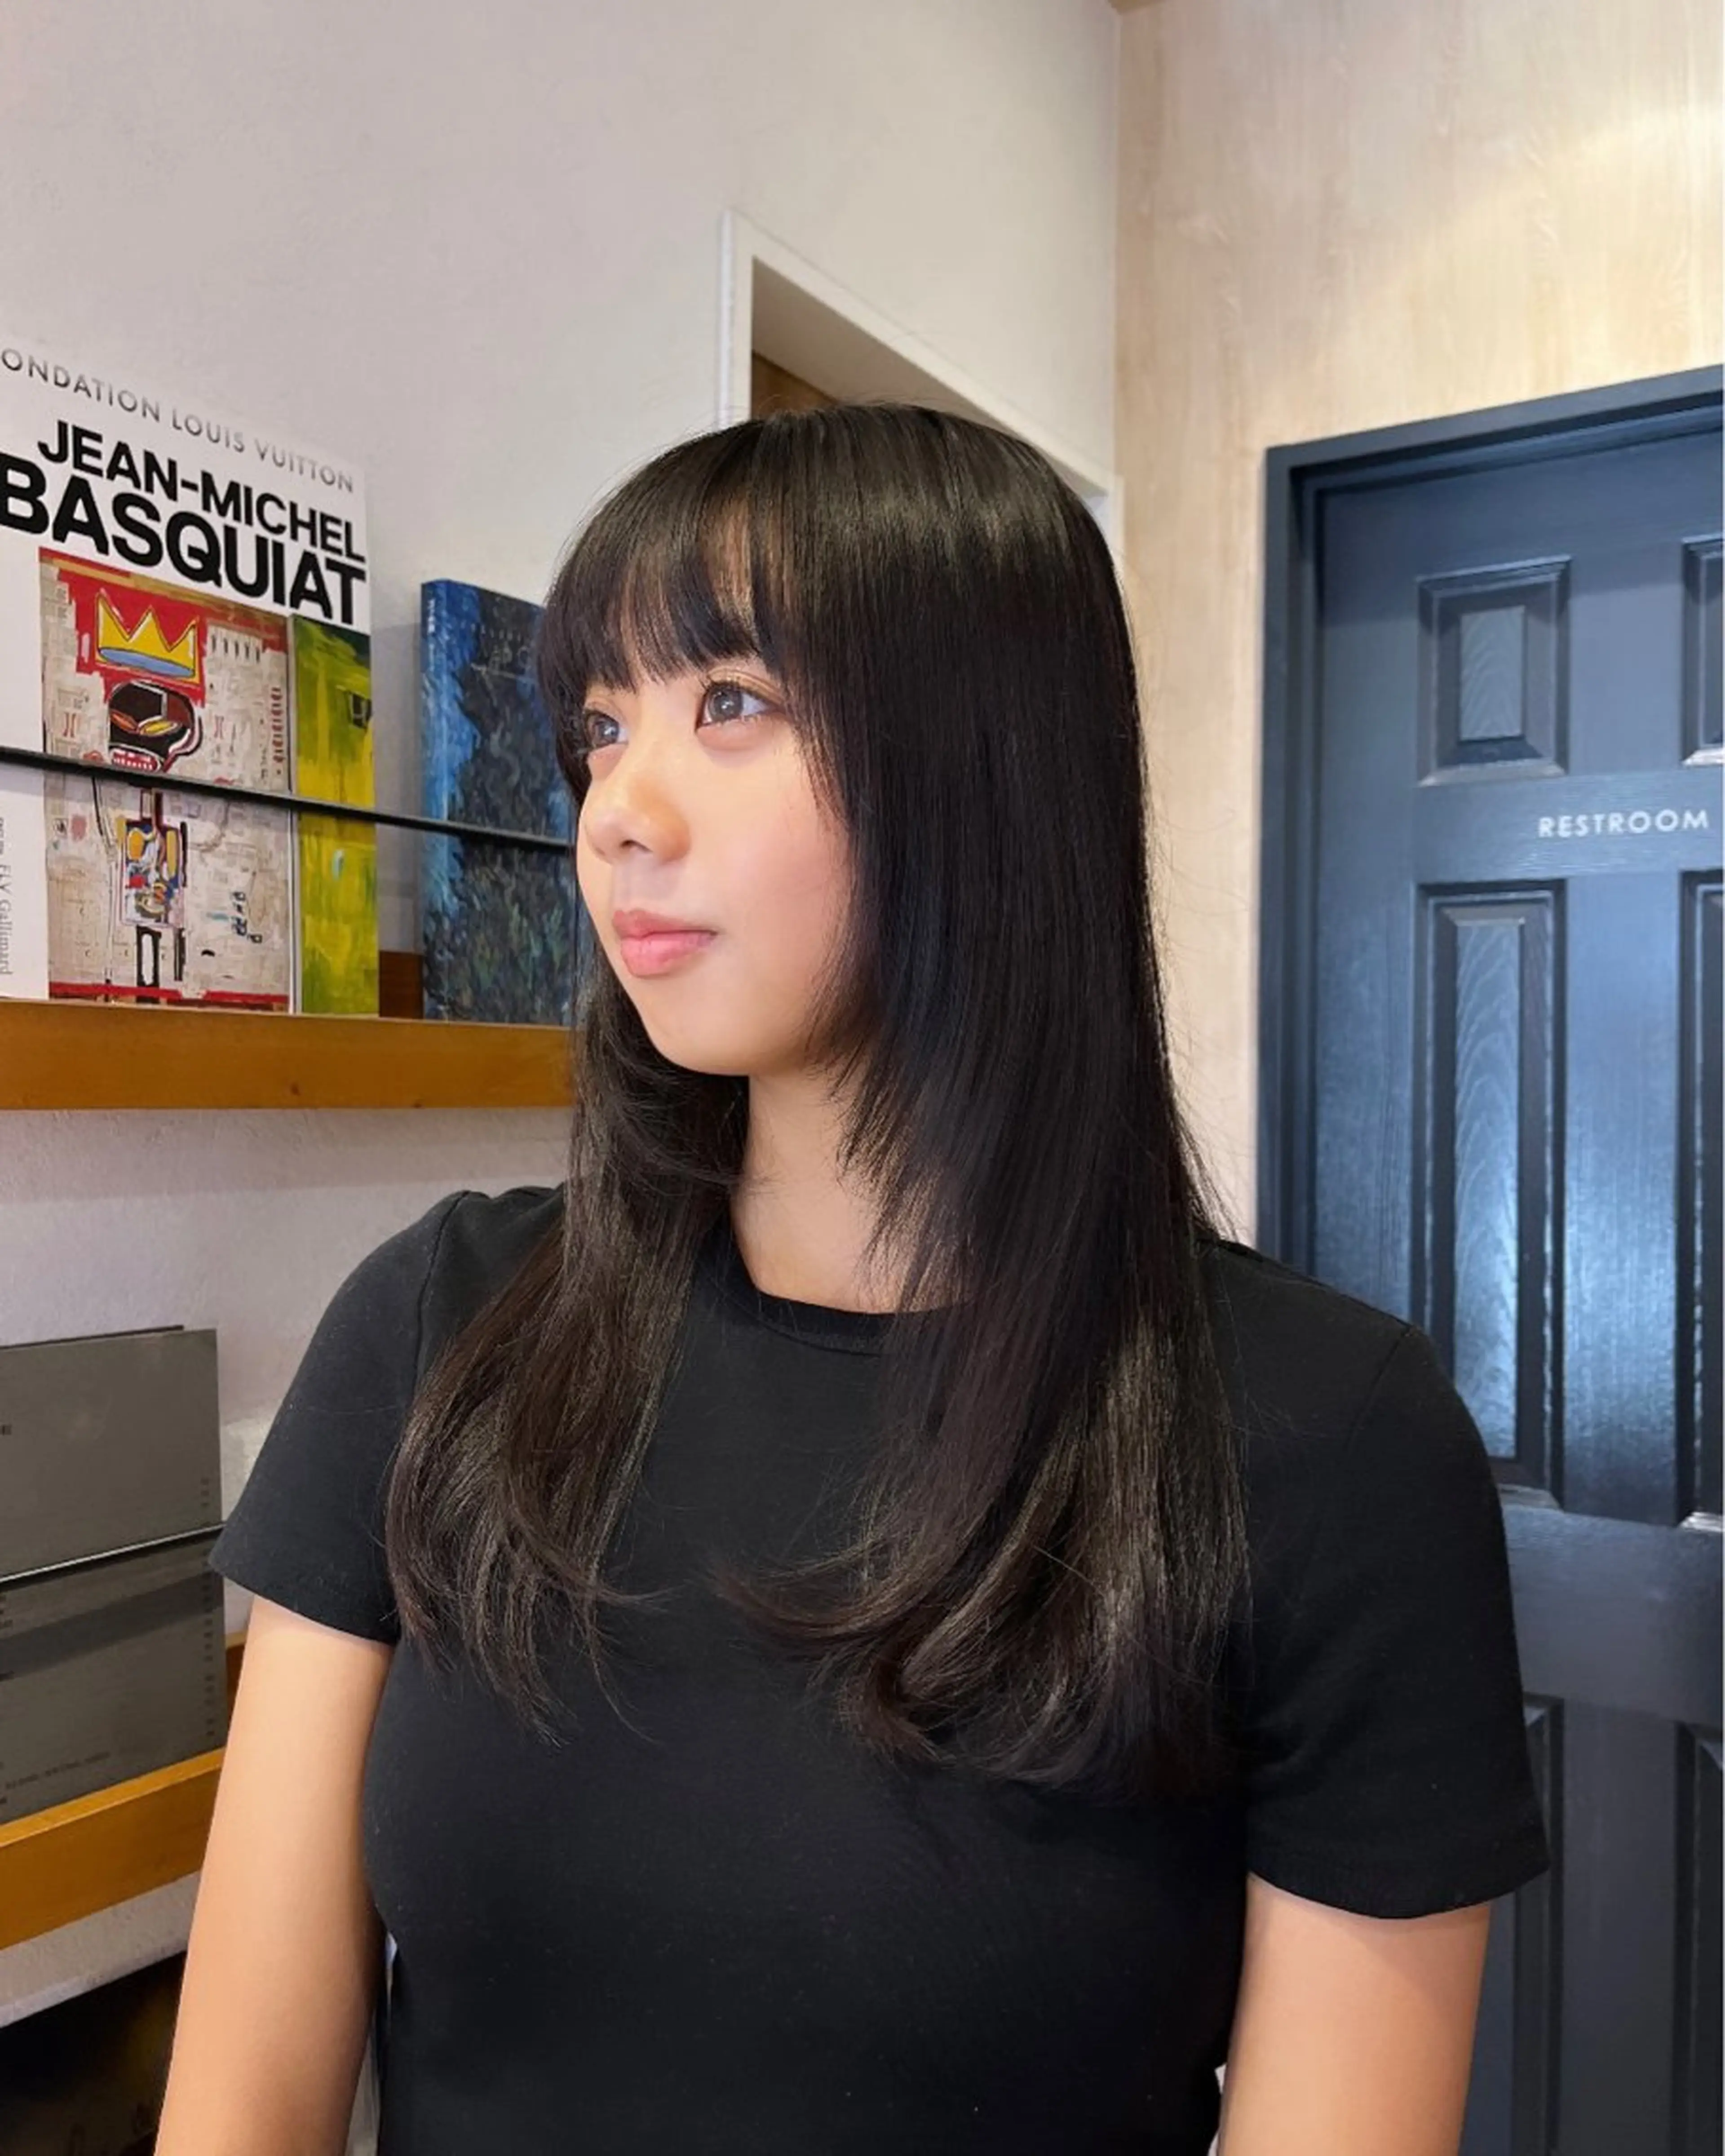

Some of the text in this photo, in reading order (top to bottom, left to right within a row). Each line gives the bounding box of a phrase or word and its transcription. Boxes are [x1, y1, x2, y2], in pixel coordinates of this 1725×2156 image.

[38, 420, 366, 563] JEAN-MICHEL
[172, 408, 245, 452] LOUIS
[255, 438, 353, 493] VUITTON
[0, 454, 366, 625] BASQUIAT
[1538, 809, 1708, 838] RESTROOM
